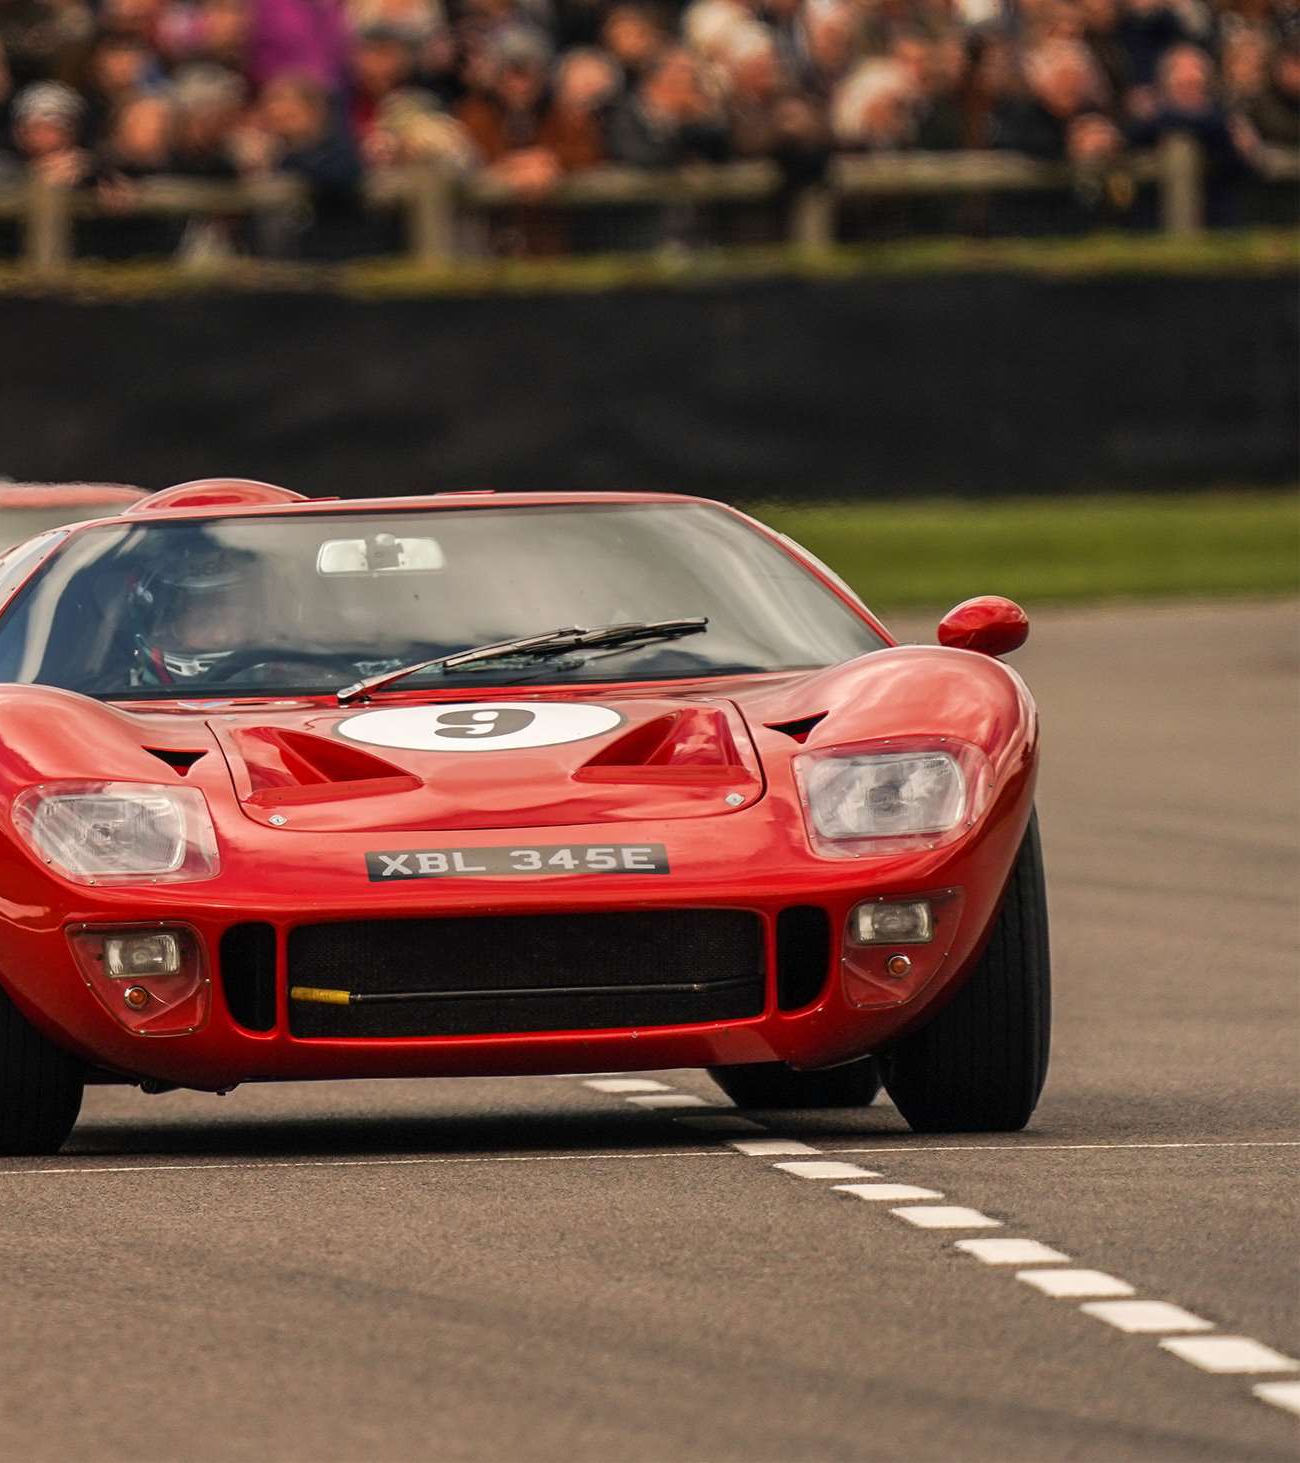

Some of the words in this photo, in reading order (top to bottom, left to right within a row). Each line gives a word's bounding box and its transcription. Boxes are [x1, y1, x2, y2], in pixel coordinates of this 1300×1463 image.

[433, 708, 536, 739] 9
[377, 851, 486, 877] XBL
[508, 847, 656, 871] 345E
